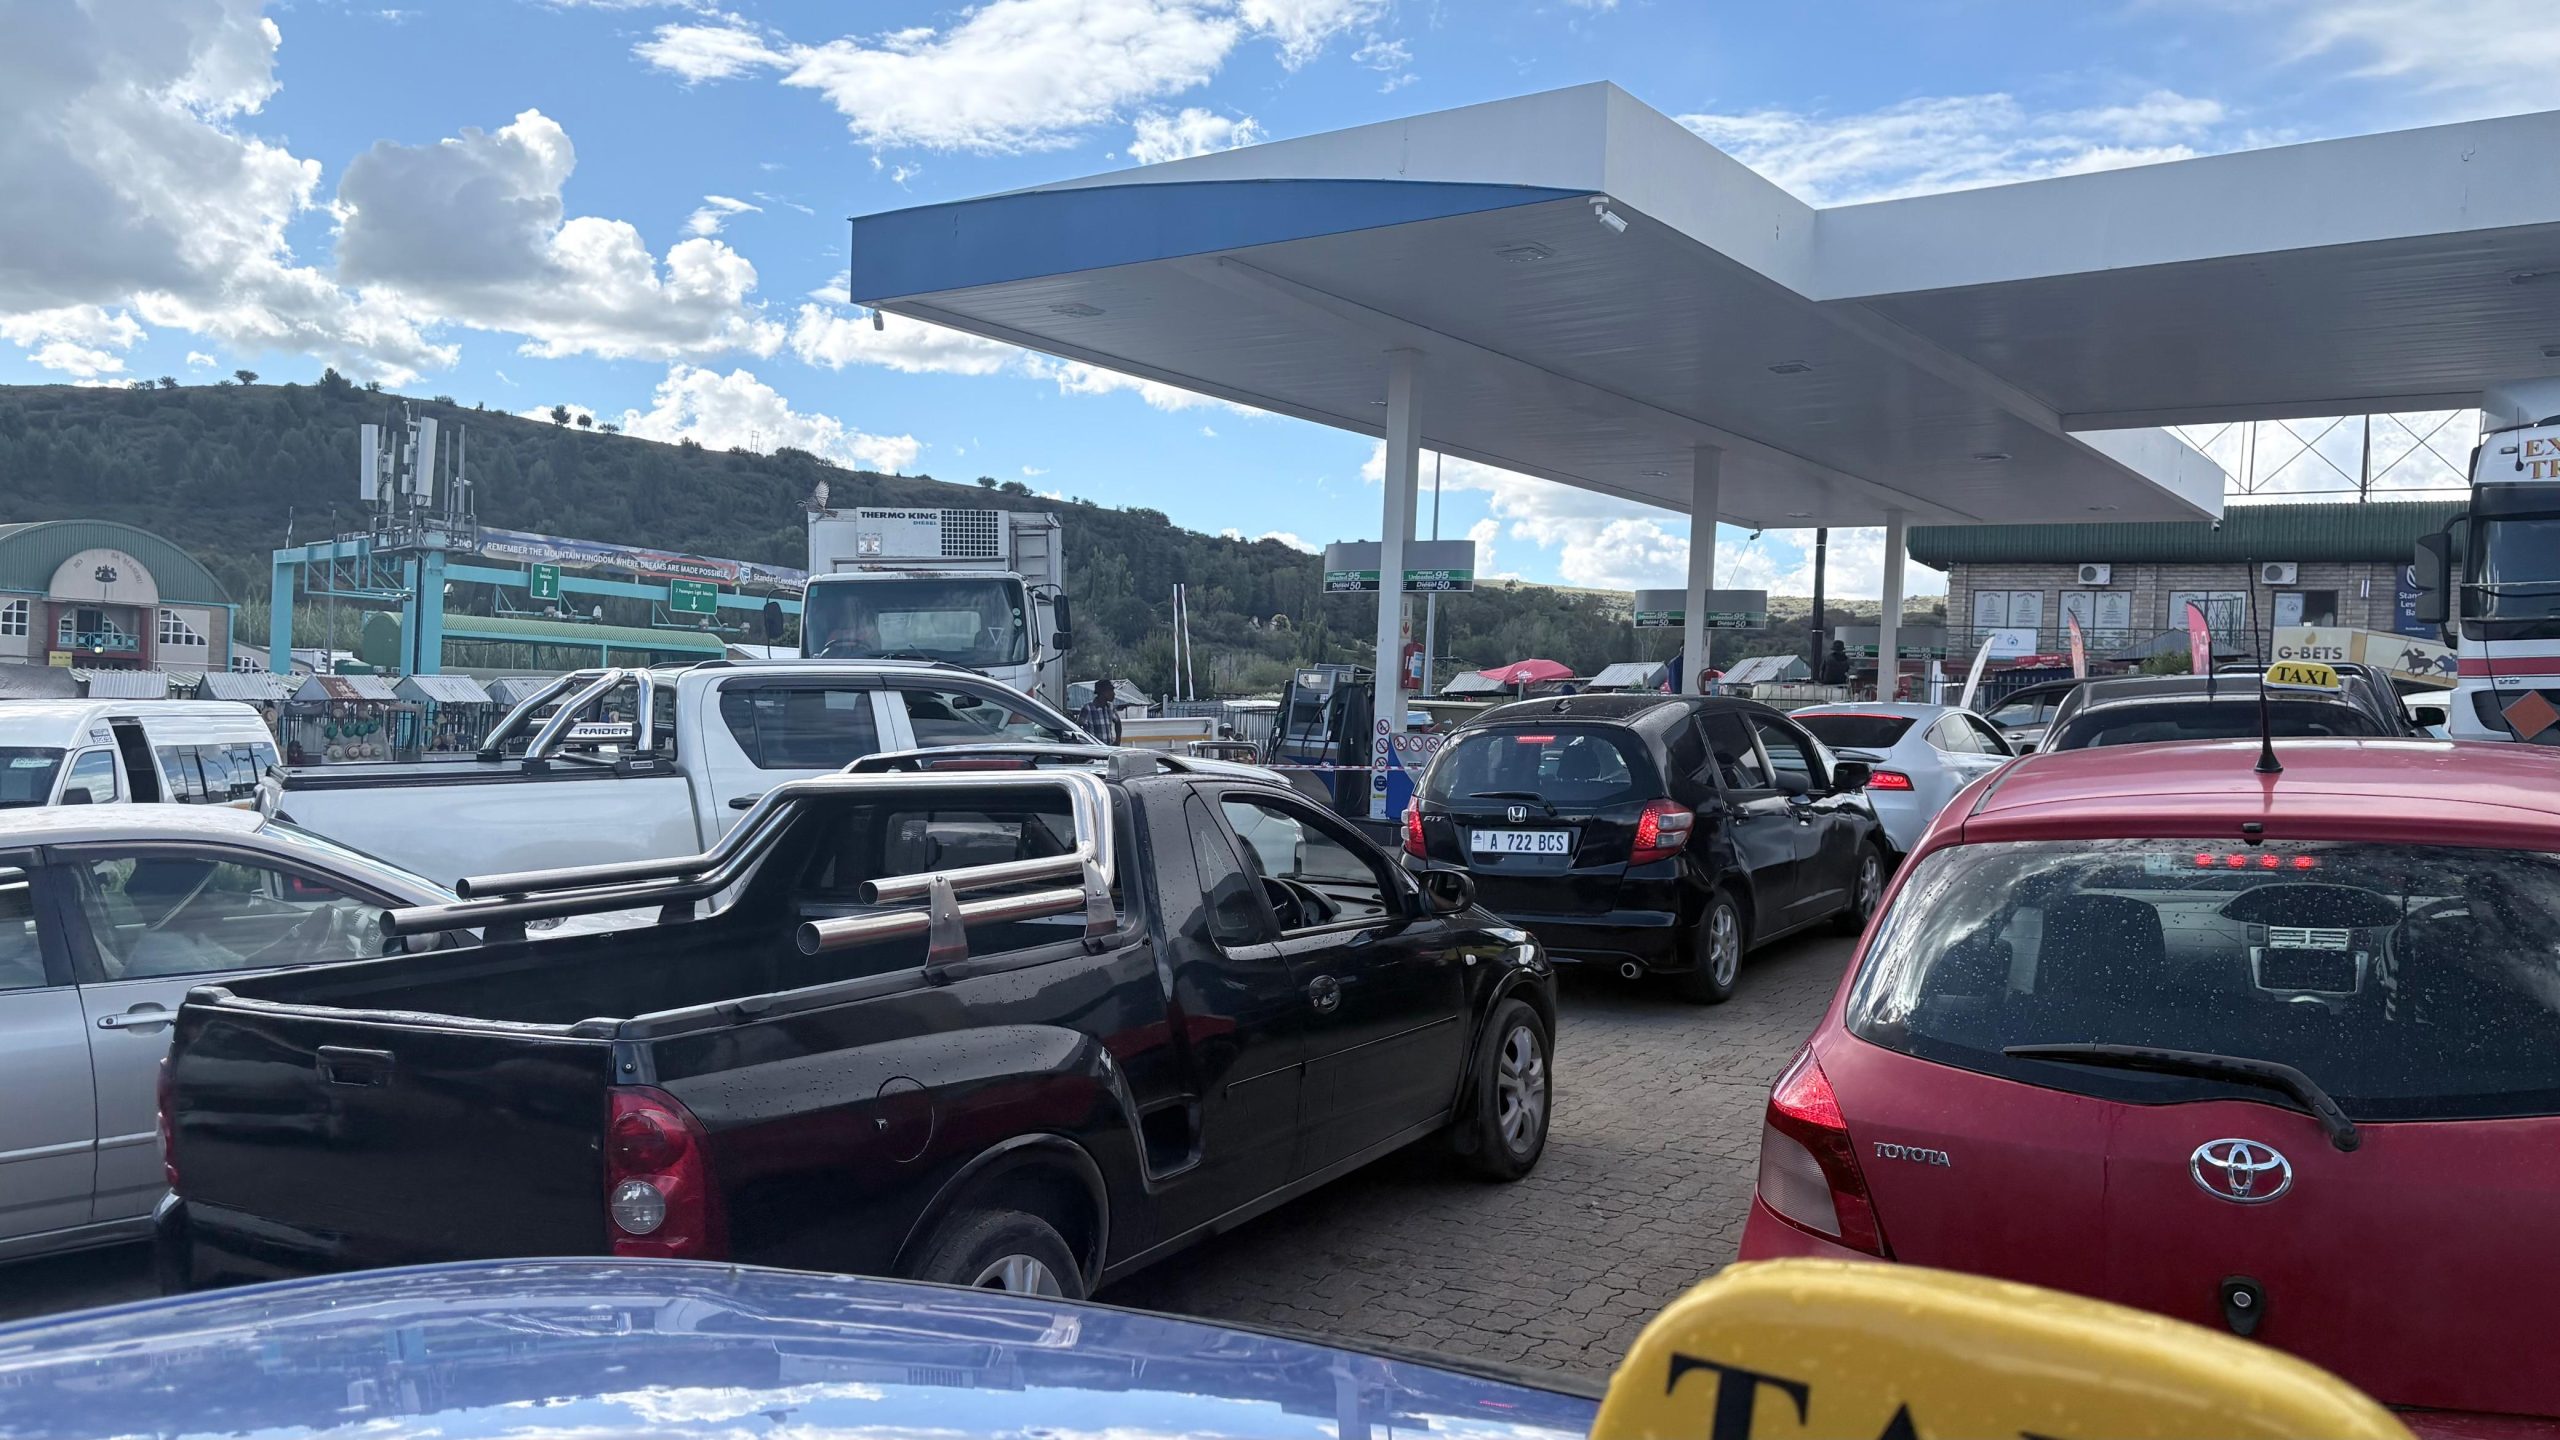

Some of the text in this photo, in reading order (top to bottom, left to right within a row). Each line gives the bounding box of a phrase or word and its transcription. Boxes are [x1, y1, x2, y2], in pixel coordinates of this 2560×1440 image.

[860, 511, 906, 519] THERMO
[486, 542, 528, 555] REMEMBER
[529, 547, 543, 556] THE
[544, 549, 580, 560] MOUNTAIN
[616, 557, 640, 568] WHERE
[640, 561, 667, 571] DREAMS
[667, 564, 680, 572] ARE
[680, 564, 698, 574] MADE
[753, 573, 778, 583] Standard
[1348, 571, 1360, 580] 95
[1435, 570, 1450, 580] 95
[1350, 582, 1361, 590] 50
[1436, 581, 1450, 590] 50
[2278, 646, 2342, 660] G-BETS
[2277, 666, 2329, 686] TAXI
[1490, 834, 1564, 851] A 722 BCS
[1874, 1142, 1950, 1168] TOYOTA
